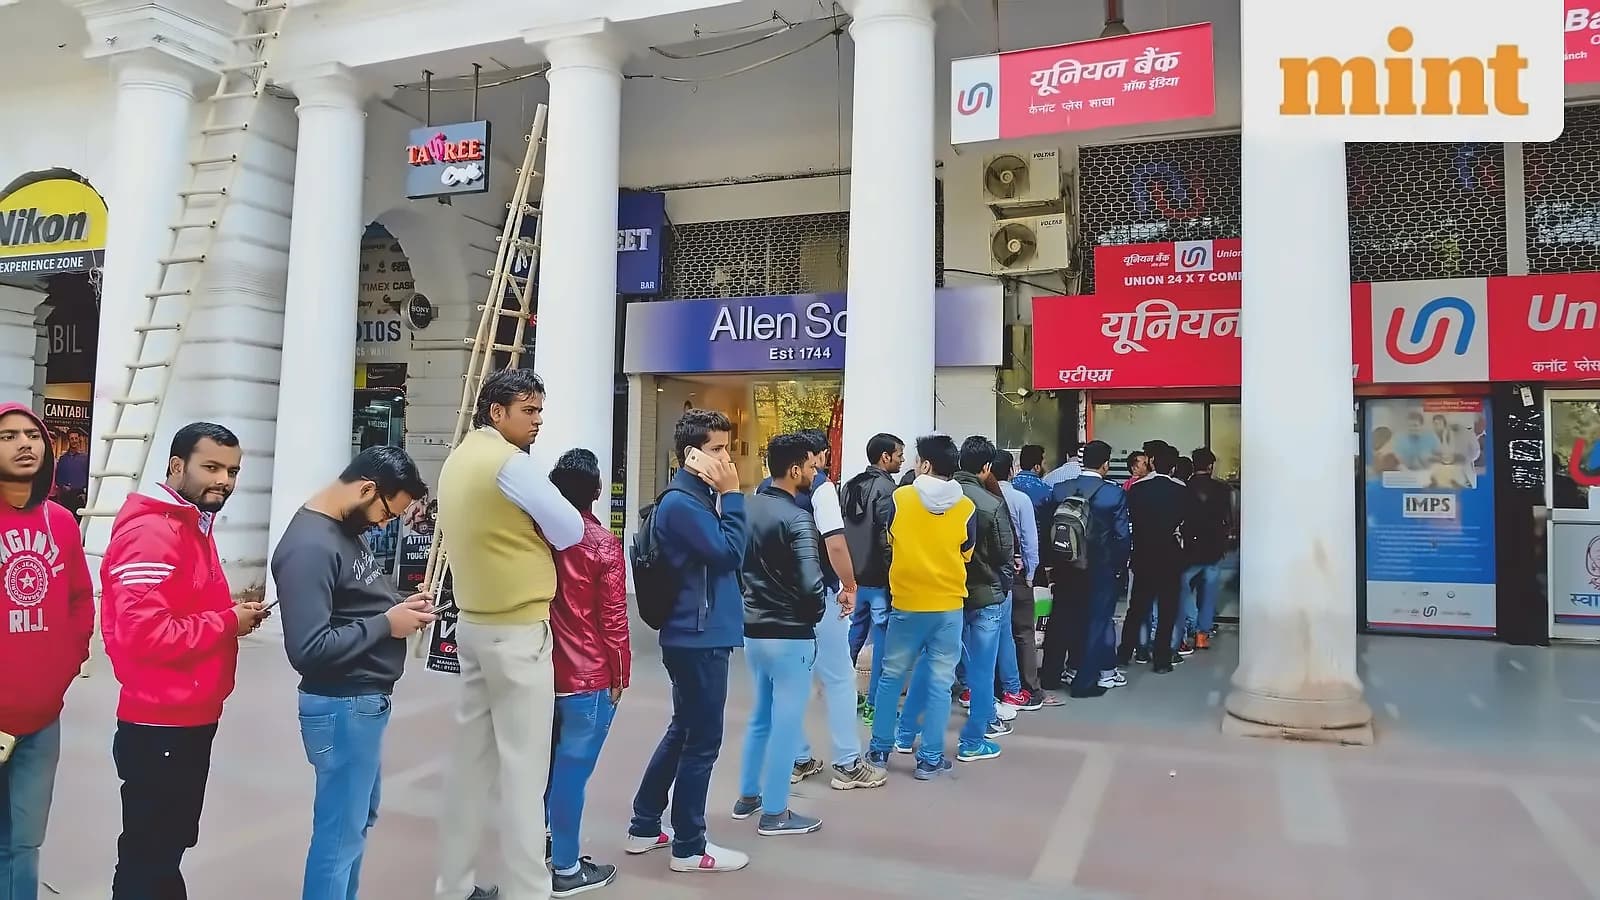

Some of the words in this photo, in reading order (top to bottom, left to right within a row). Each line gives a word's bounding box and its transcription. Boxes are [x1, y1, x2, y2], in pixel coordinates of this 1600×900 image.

[1030, 58, 1128, 96] यूनियन
[1134, 46, 1182, 75] बैंक
[1033, 151, 1056, 159] VOLTAS
[0, 207, 88, 246] Nikon
[1040, 219, 1063, 227] VOLTAS
[0, 259, 55, 274] EXPERIENCE
[57, 256, 84, 270] ZONE
[362, 282, 390, 292] TIMEX
[641, 281, 655, 290] BAR
[1124, 275, 1165, 287] UNION
[1167, 274, 1183, 285] 24
[1186, 273, 1196, 284] X
[1197, 273, 1206, 283] 7
[411, 305, 430, 314] SONY
[709, 305, 797, 341] Allen
[769, 347, 795, 361] Est
[799, 346, 832, 360] 1744
[1531, 358, 1568, 373] कनॉट
[1058, 365, 1114, 383] एटीएम
[44, 403, 90, 419] CANTABIL
[1405, 496, 1451, 513] IMPS
[9, 607, 49, 633] RIJ.
